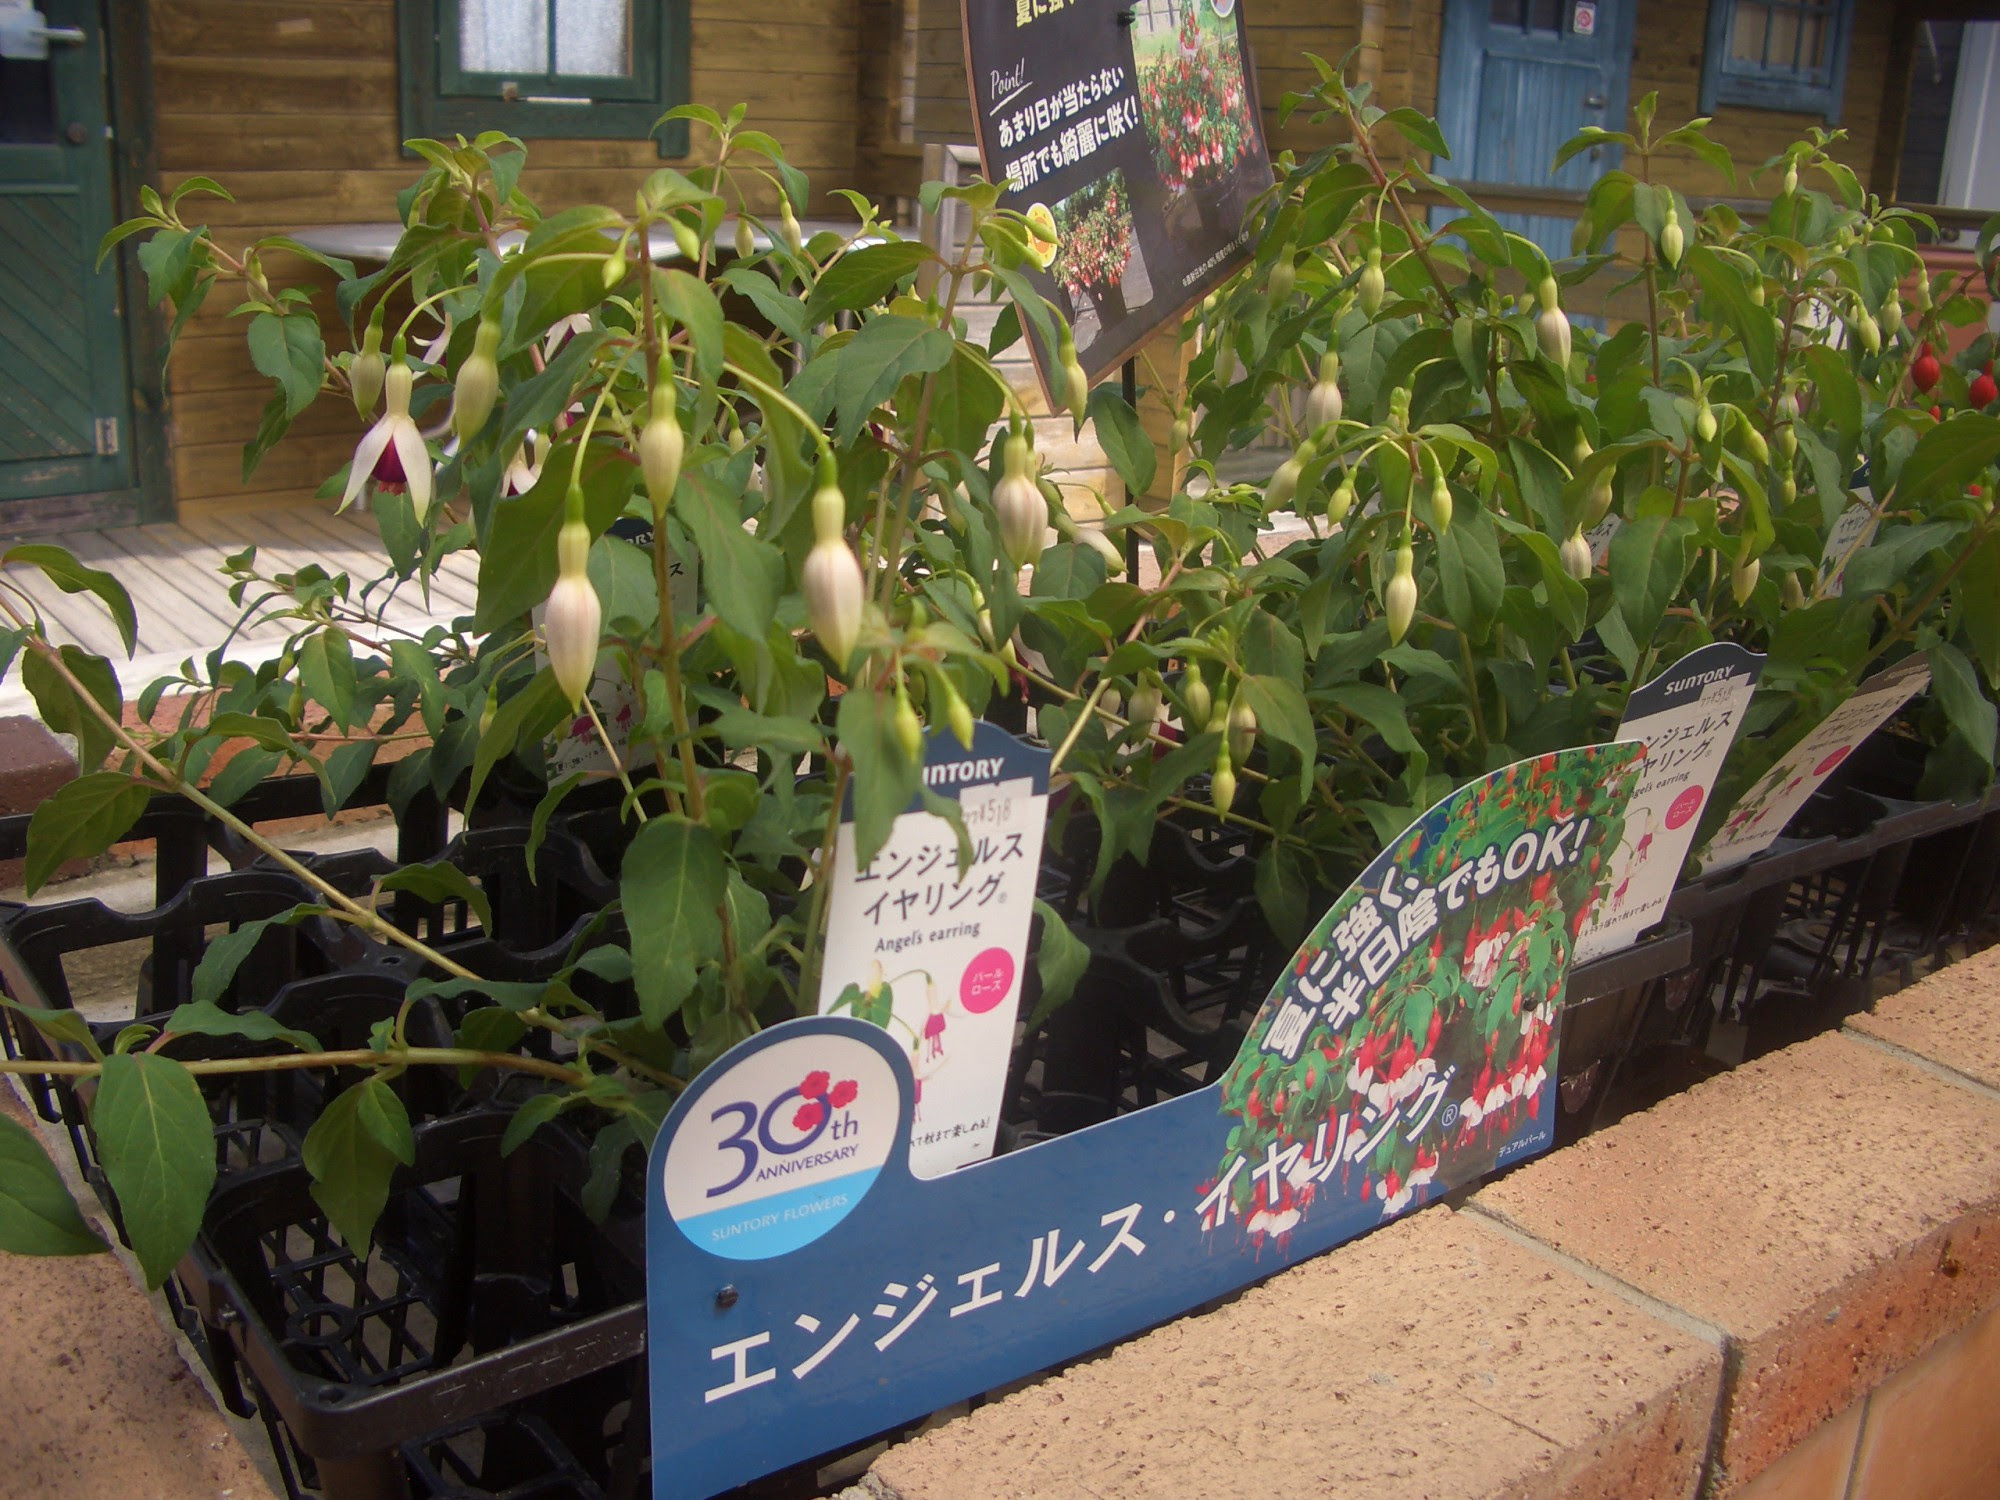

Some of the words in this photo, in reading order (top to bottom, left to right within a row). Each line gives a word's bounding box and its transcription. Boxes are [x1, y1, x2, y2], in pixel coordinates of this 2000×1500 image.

[990, 57, 1025, 99] Point!
[999, 66, 1124, 148] あまり日が当たらない
[1006, 95, 1139, 193] 場所でも綺麗に咲く!
[1664, 664, 1735, 695] SUNTORY
[1646, 711, 1733, 749] ンジェルス
[923, 757, 1005, 785] NTORY
[1643, 736, 1714, 778] ヤリング
[1656, 771, 1690, 788] earring
[875, 929, 923, 953] Angel's
[929, 922, 981, 942] earring
[1322, 818, 1590, 1030] 半日陰でもOK!
[1261, 866, 1420, 1059] 夏に強く、
[970, 981, 1002, 996] ローズ
[756, 1144, 860, 1182] ANNIVERSARY
[1499, 1130, 1547, 1158] デュアルパール
[711, 1212, 780, 1242] SUNTORY
[783, 1193, 849, 1222] FLOWERS
